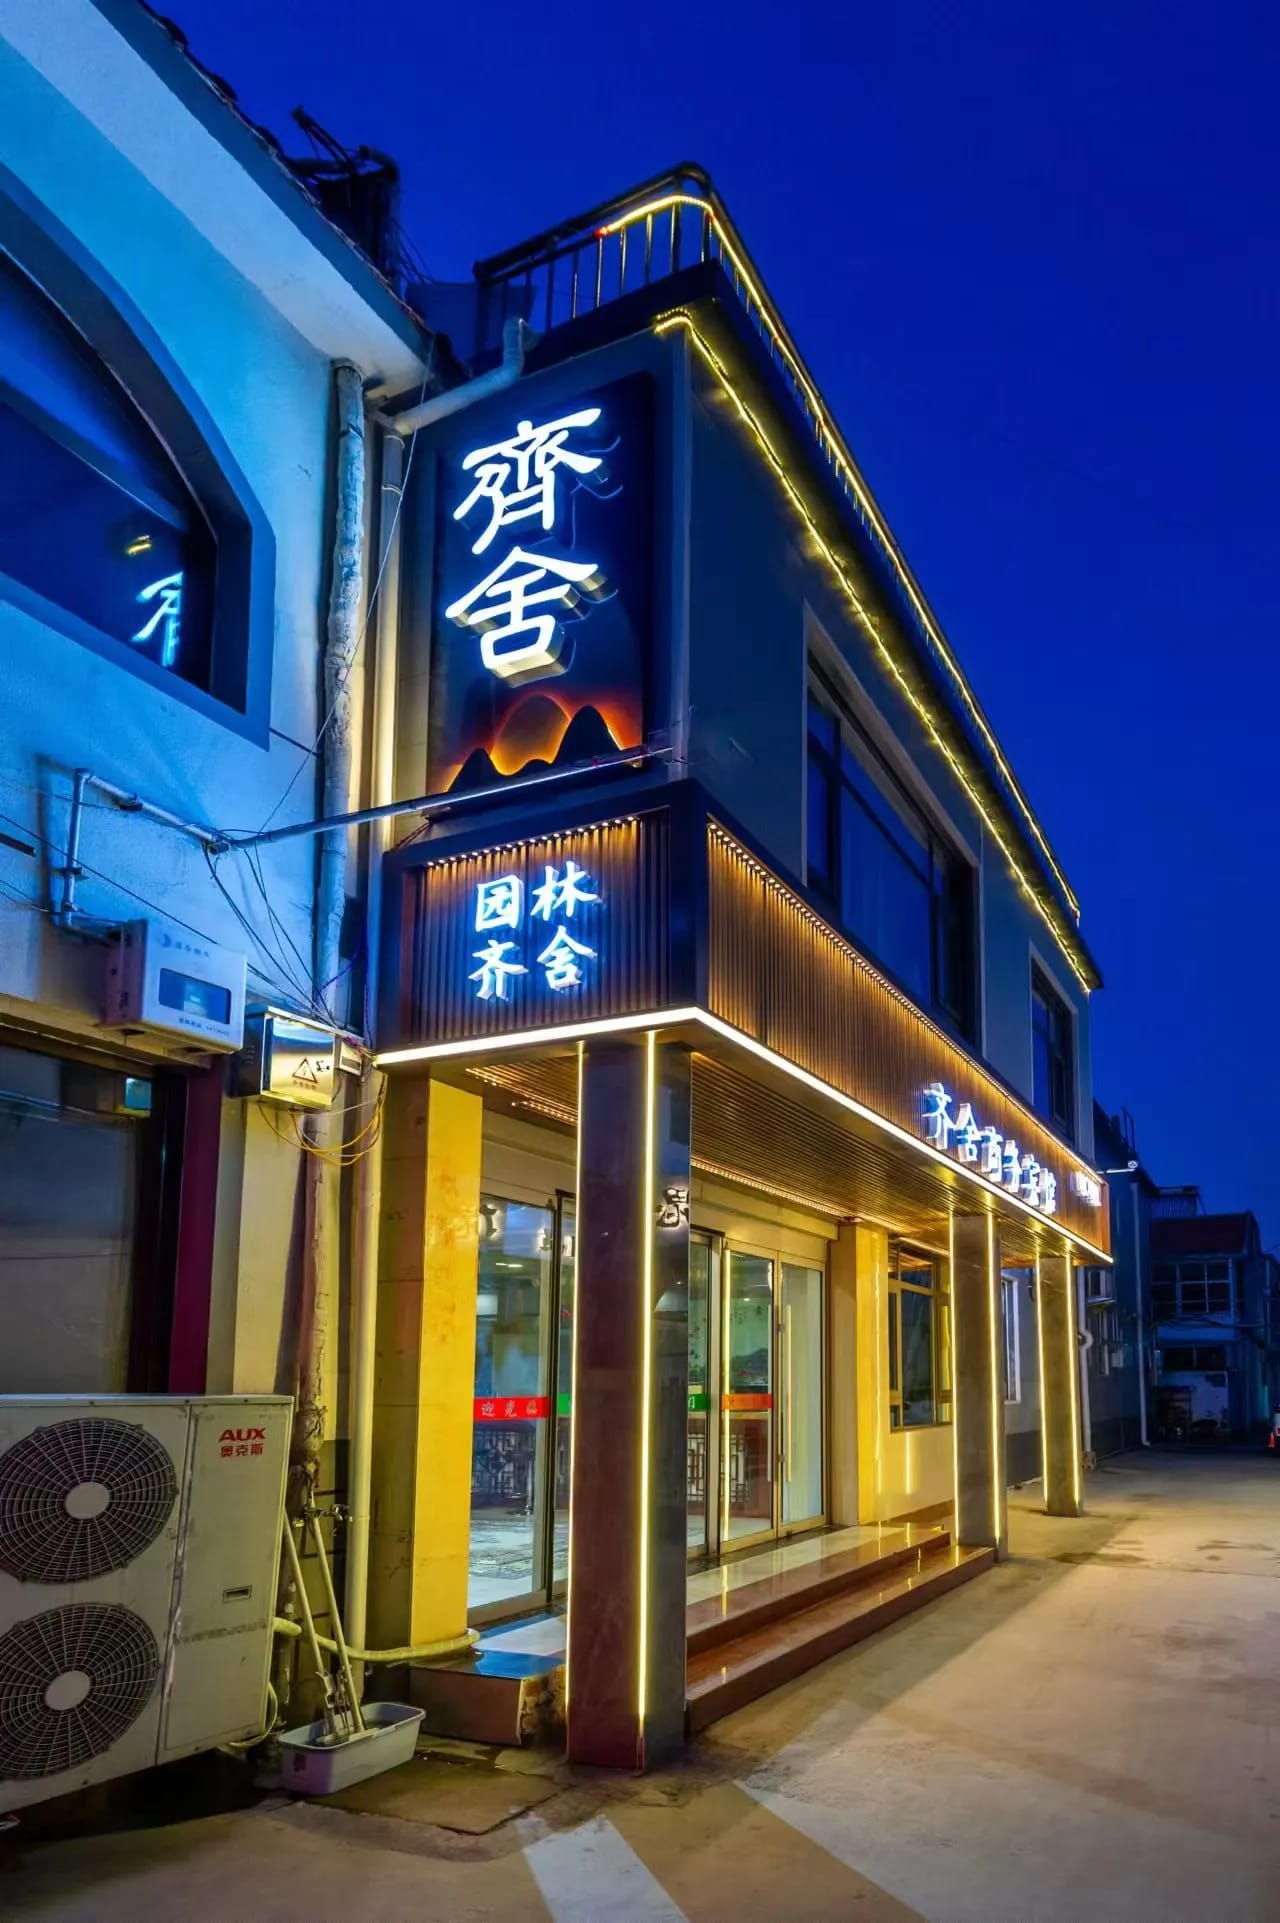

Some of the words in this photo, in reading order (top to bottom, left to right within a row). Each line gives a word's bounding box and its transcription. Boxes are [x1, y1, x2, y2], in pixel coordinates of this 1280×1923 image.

[445, 408, 604, 674] 齊舍
[474, 860, 599, 932] 园林
[468, 925, 599, 1001] 齐舍
[218, 1427, 266, 1442] AUX
[219, 1443, 264, 1457] 奥克斯
